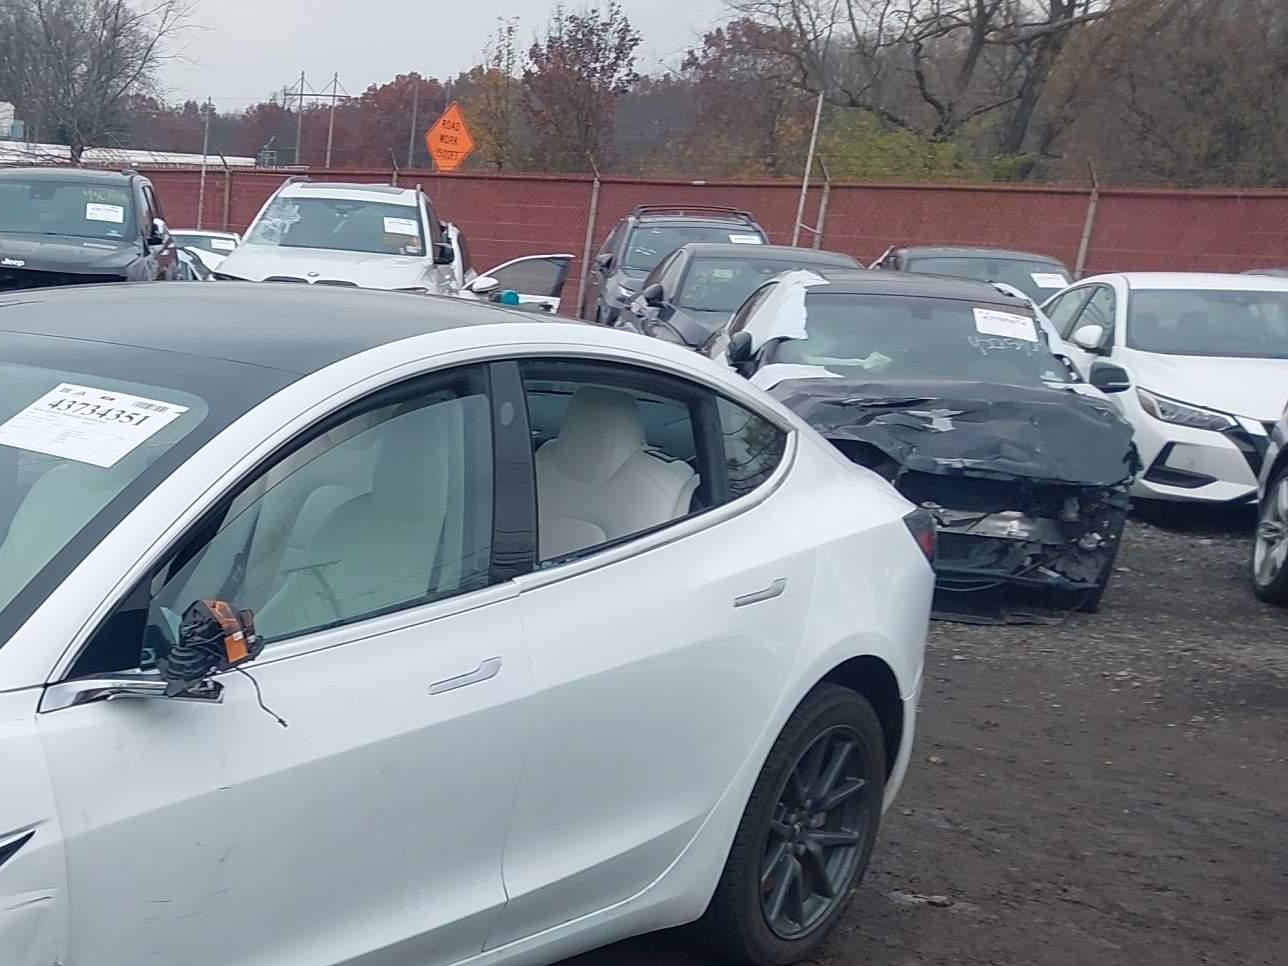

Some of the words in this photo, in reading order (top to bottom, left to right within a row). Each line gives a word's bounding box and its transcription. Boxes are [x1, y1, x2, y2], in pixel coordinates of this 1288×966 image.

[441, 119, 461, 131] ROAD
[0, 257, 25, 267] Jeep
[47, 398, 152, 426] 43734351
